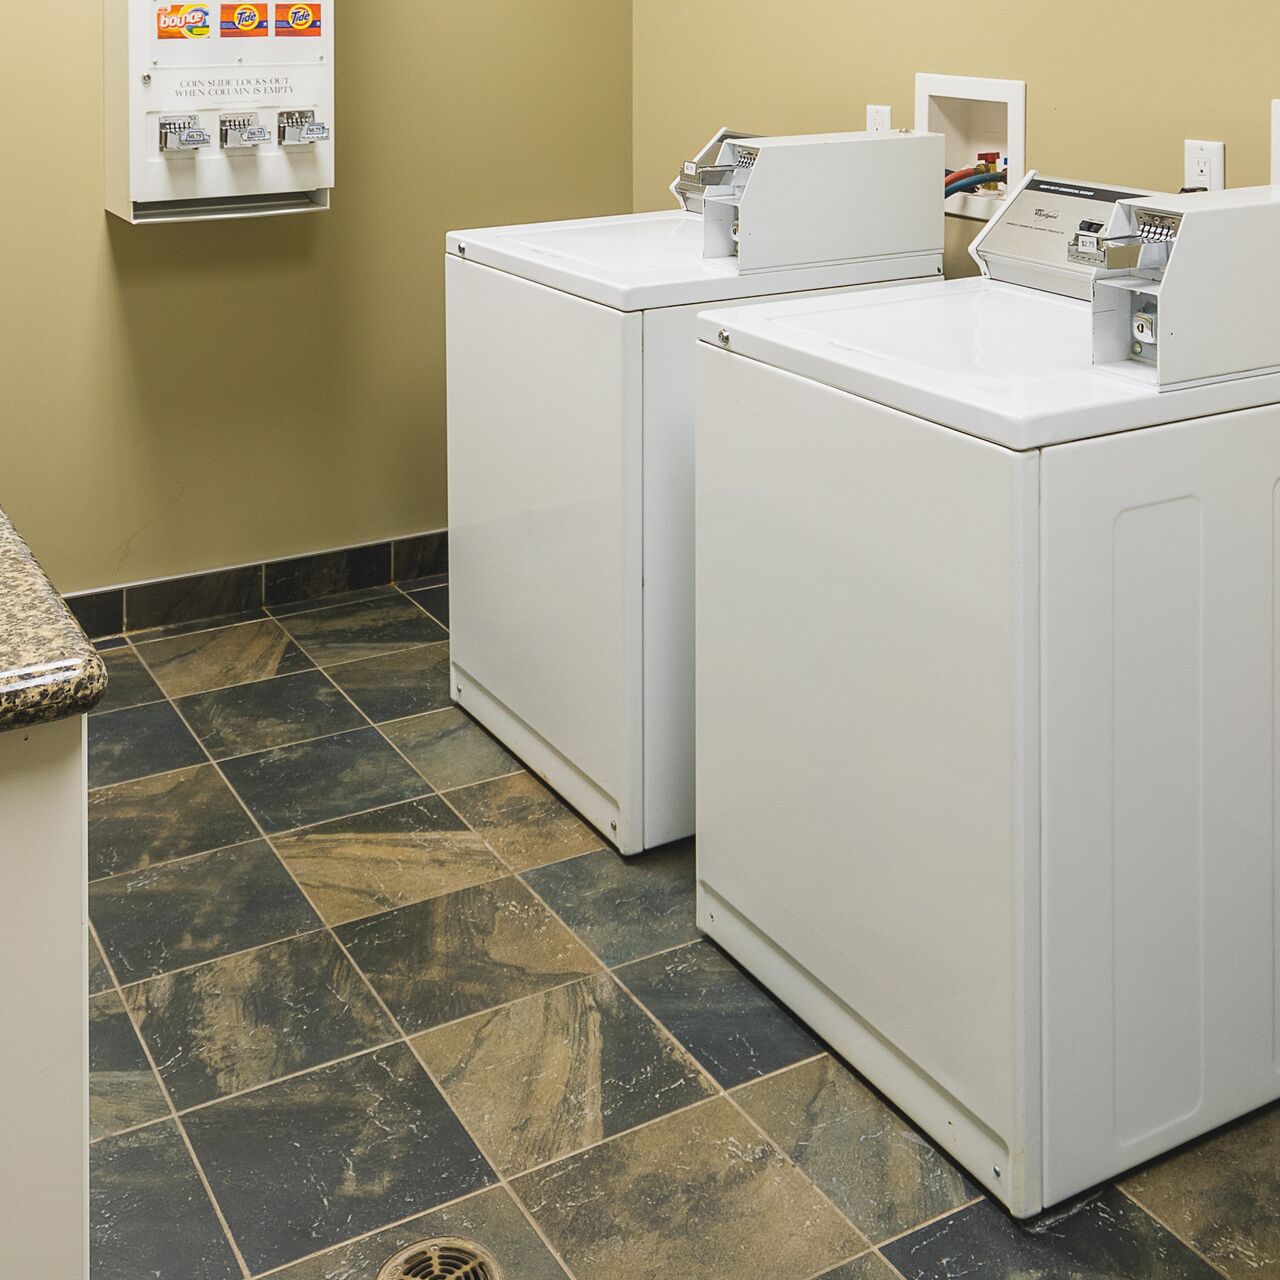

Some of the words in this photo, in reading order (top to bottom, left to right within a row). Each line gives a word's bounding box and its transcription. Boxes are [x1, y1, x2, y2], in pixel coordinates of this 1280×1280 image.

[236, 9, 257, 25] Tide
[291, 9, 310, 25] Tide
[180, 80, 205, 88] COIN
[207, 79, 232, 87] SLIDE
[236, 78, 267, 87] LOCKS
[269, 77, 289, 85] OUT
[175, 88, 205, 97] WHEN
[208, 87, 250, 96] COLUMN
[253, 87, 261, 95] IS
[264, 86, 294, 95] EMPTY
[1081, 240, 1096, 248] $2.75
